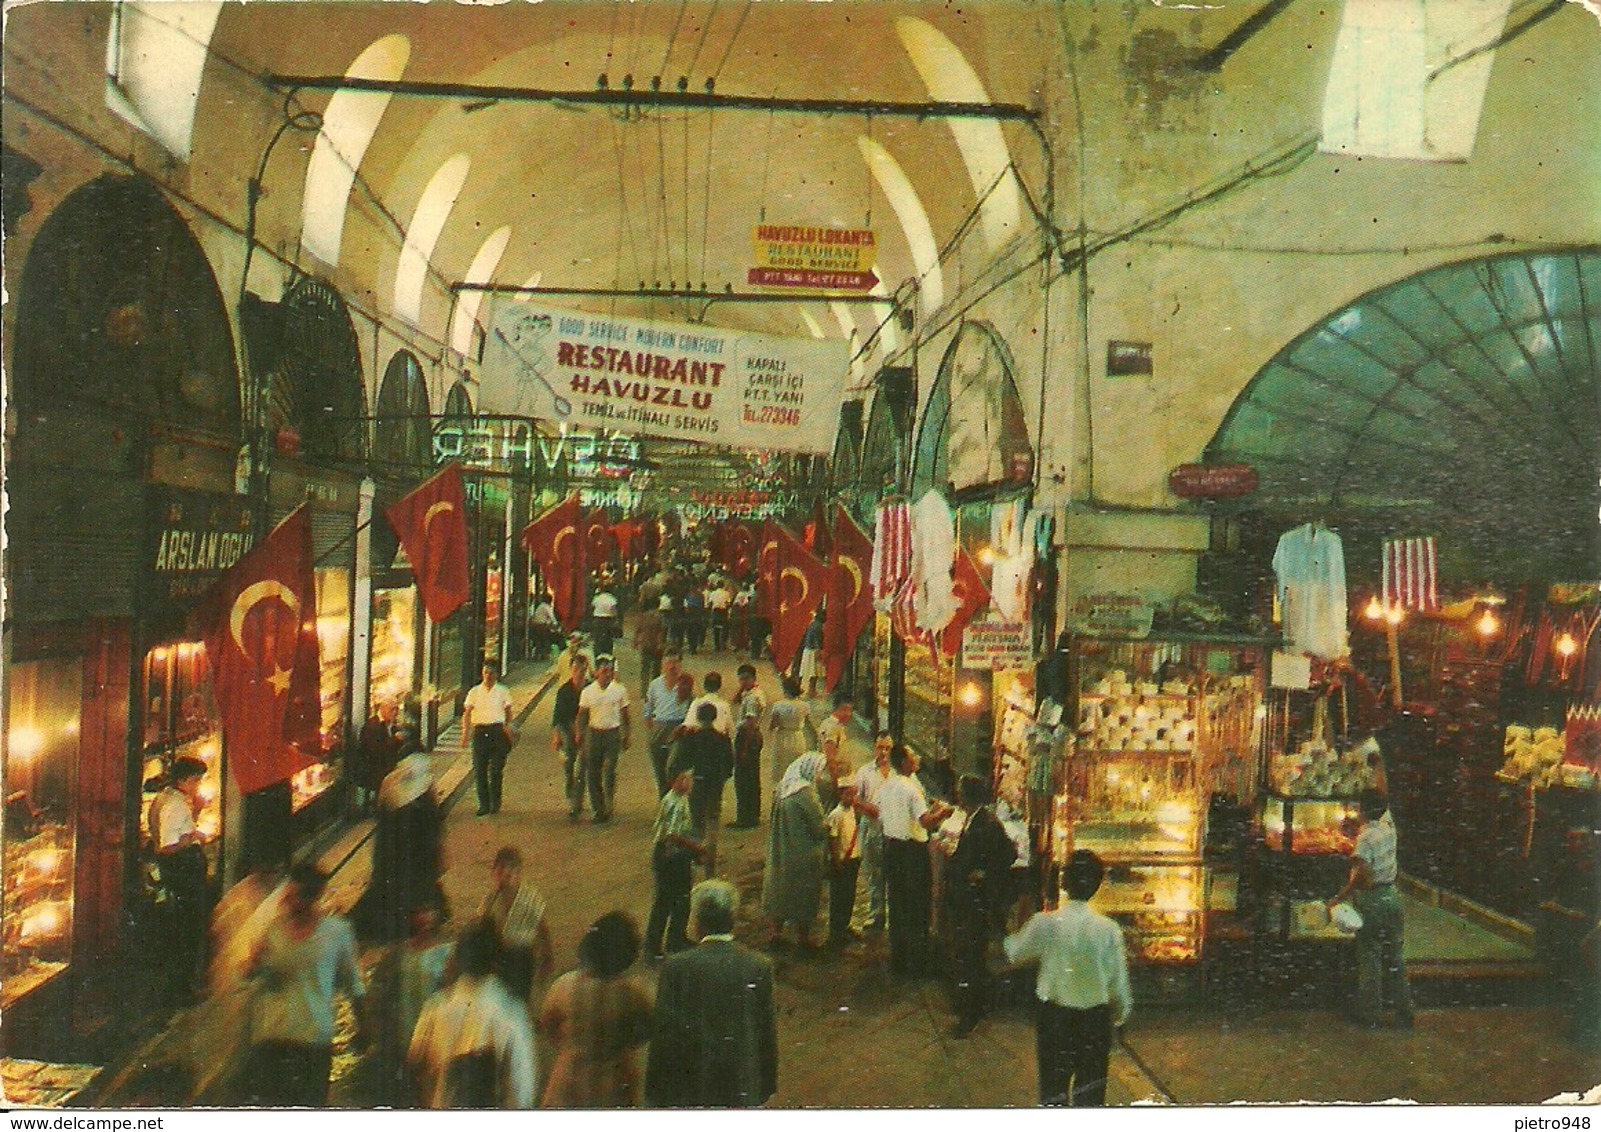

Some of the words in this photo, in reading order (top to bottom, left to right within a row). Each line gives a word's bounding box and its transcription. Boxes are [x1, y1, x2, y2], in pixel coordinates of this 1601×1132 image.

[758, 225, 815, 243] HAVUZLU
[818, 228, 875, 247] LOKANTA
[559, 317, 585, 336] GOOD
[589, 321, 628, 342] SERVICE
[569, 373, 713, 410] HAVUZLU
[155, 530, 218, 570] ARSLAN
